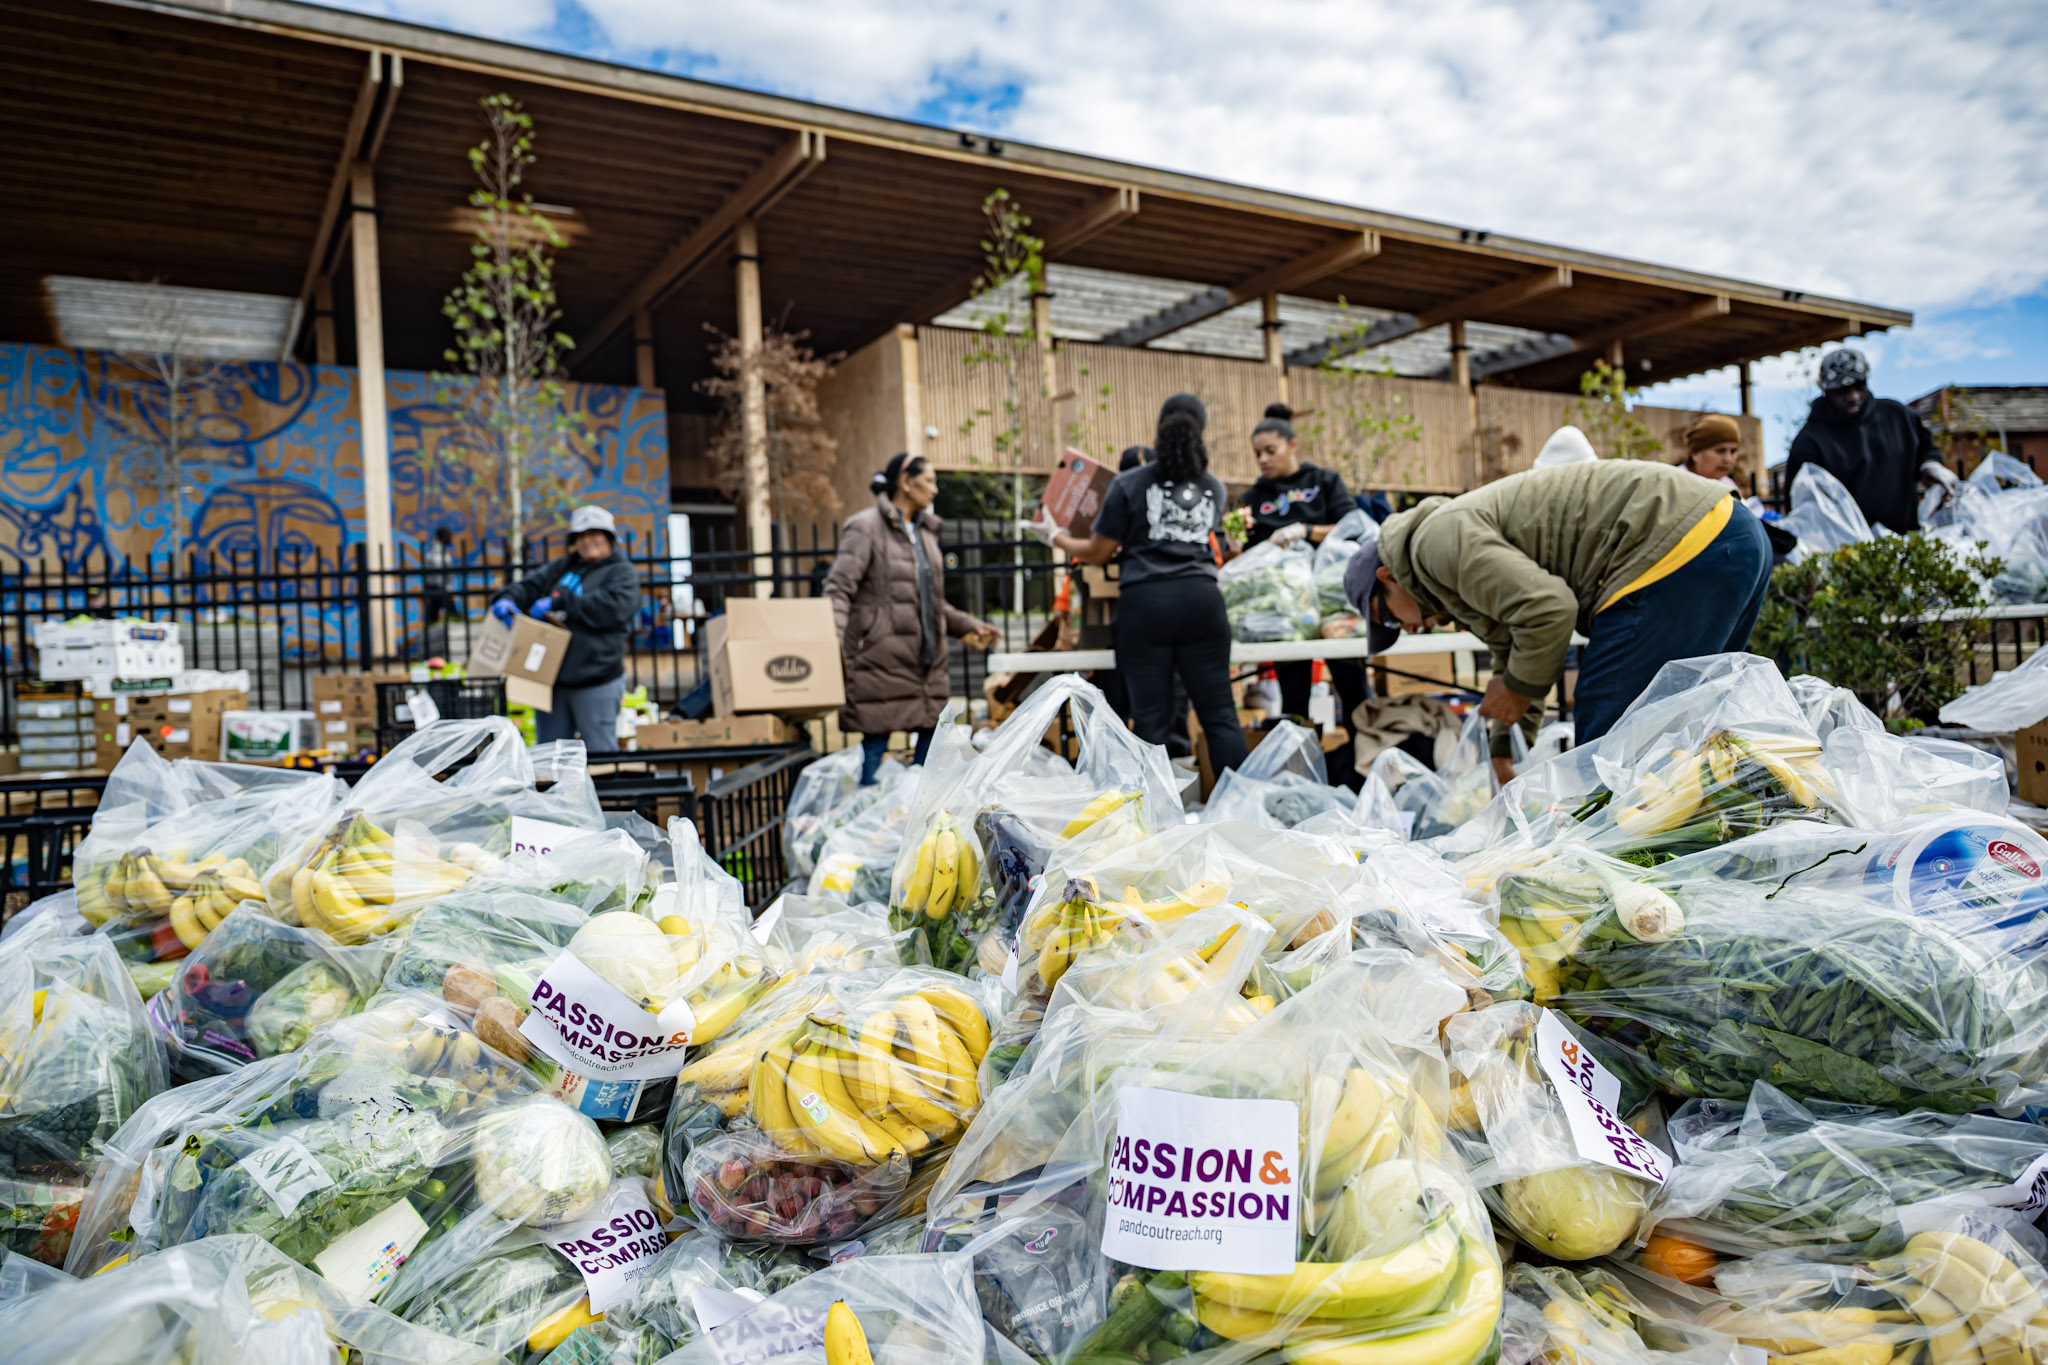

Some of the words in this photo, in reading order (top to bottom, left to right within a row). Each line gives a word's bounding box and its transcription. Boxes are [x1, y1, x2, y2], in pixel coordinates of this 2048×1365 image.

[1993, 842, 2039, 876] Galbani
[532, 980, 664, 1049] PASSION
[1111, 1135, 1253, 1184] PASSION
[1108, 1176, 1290, 1221] COMPASSION
[580, 1232, 667, 1274] COMPASS
[1118, 1218, 1223, 1245] pandcoutreach.org
